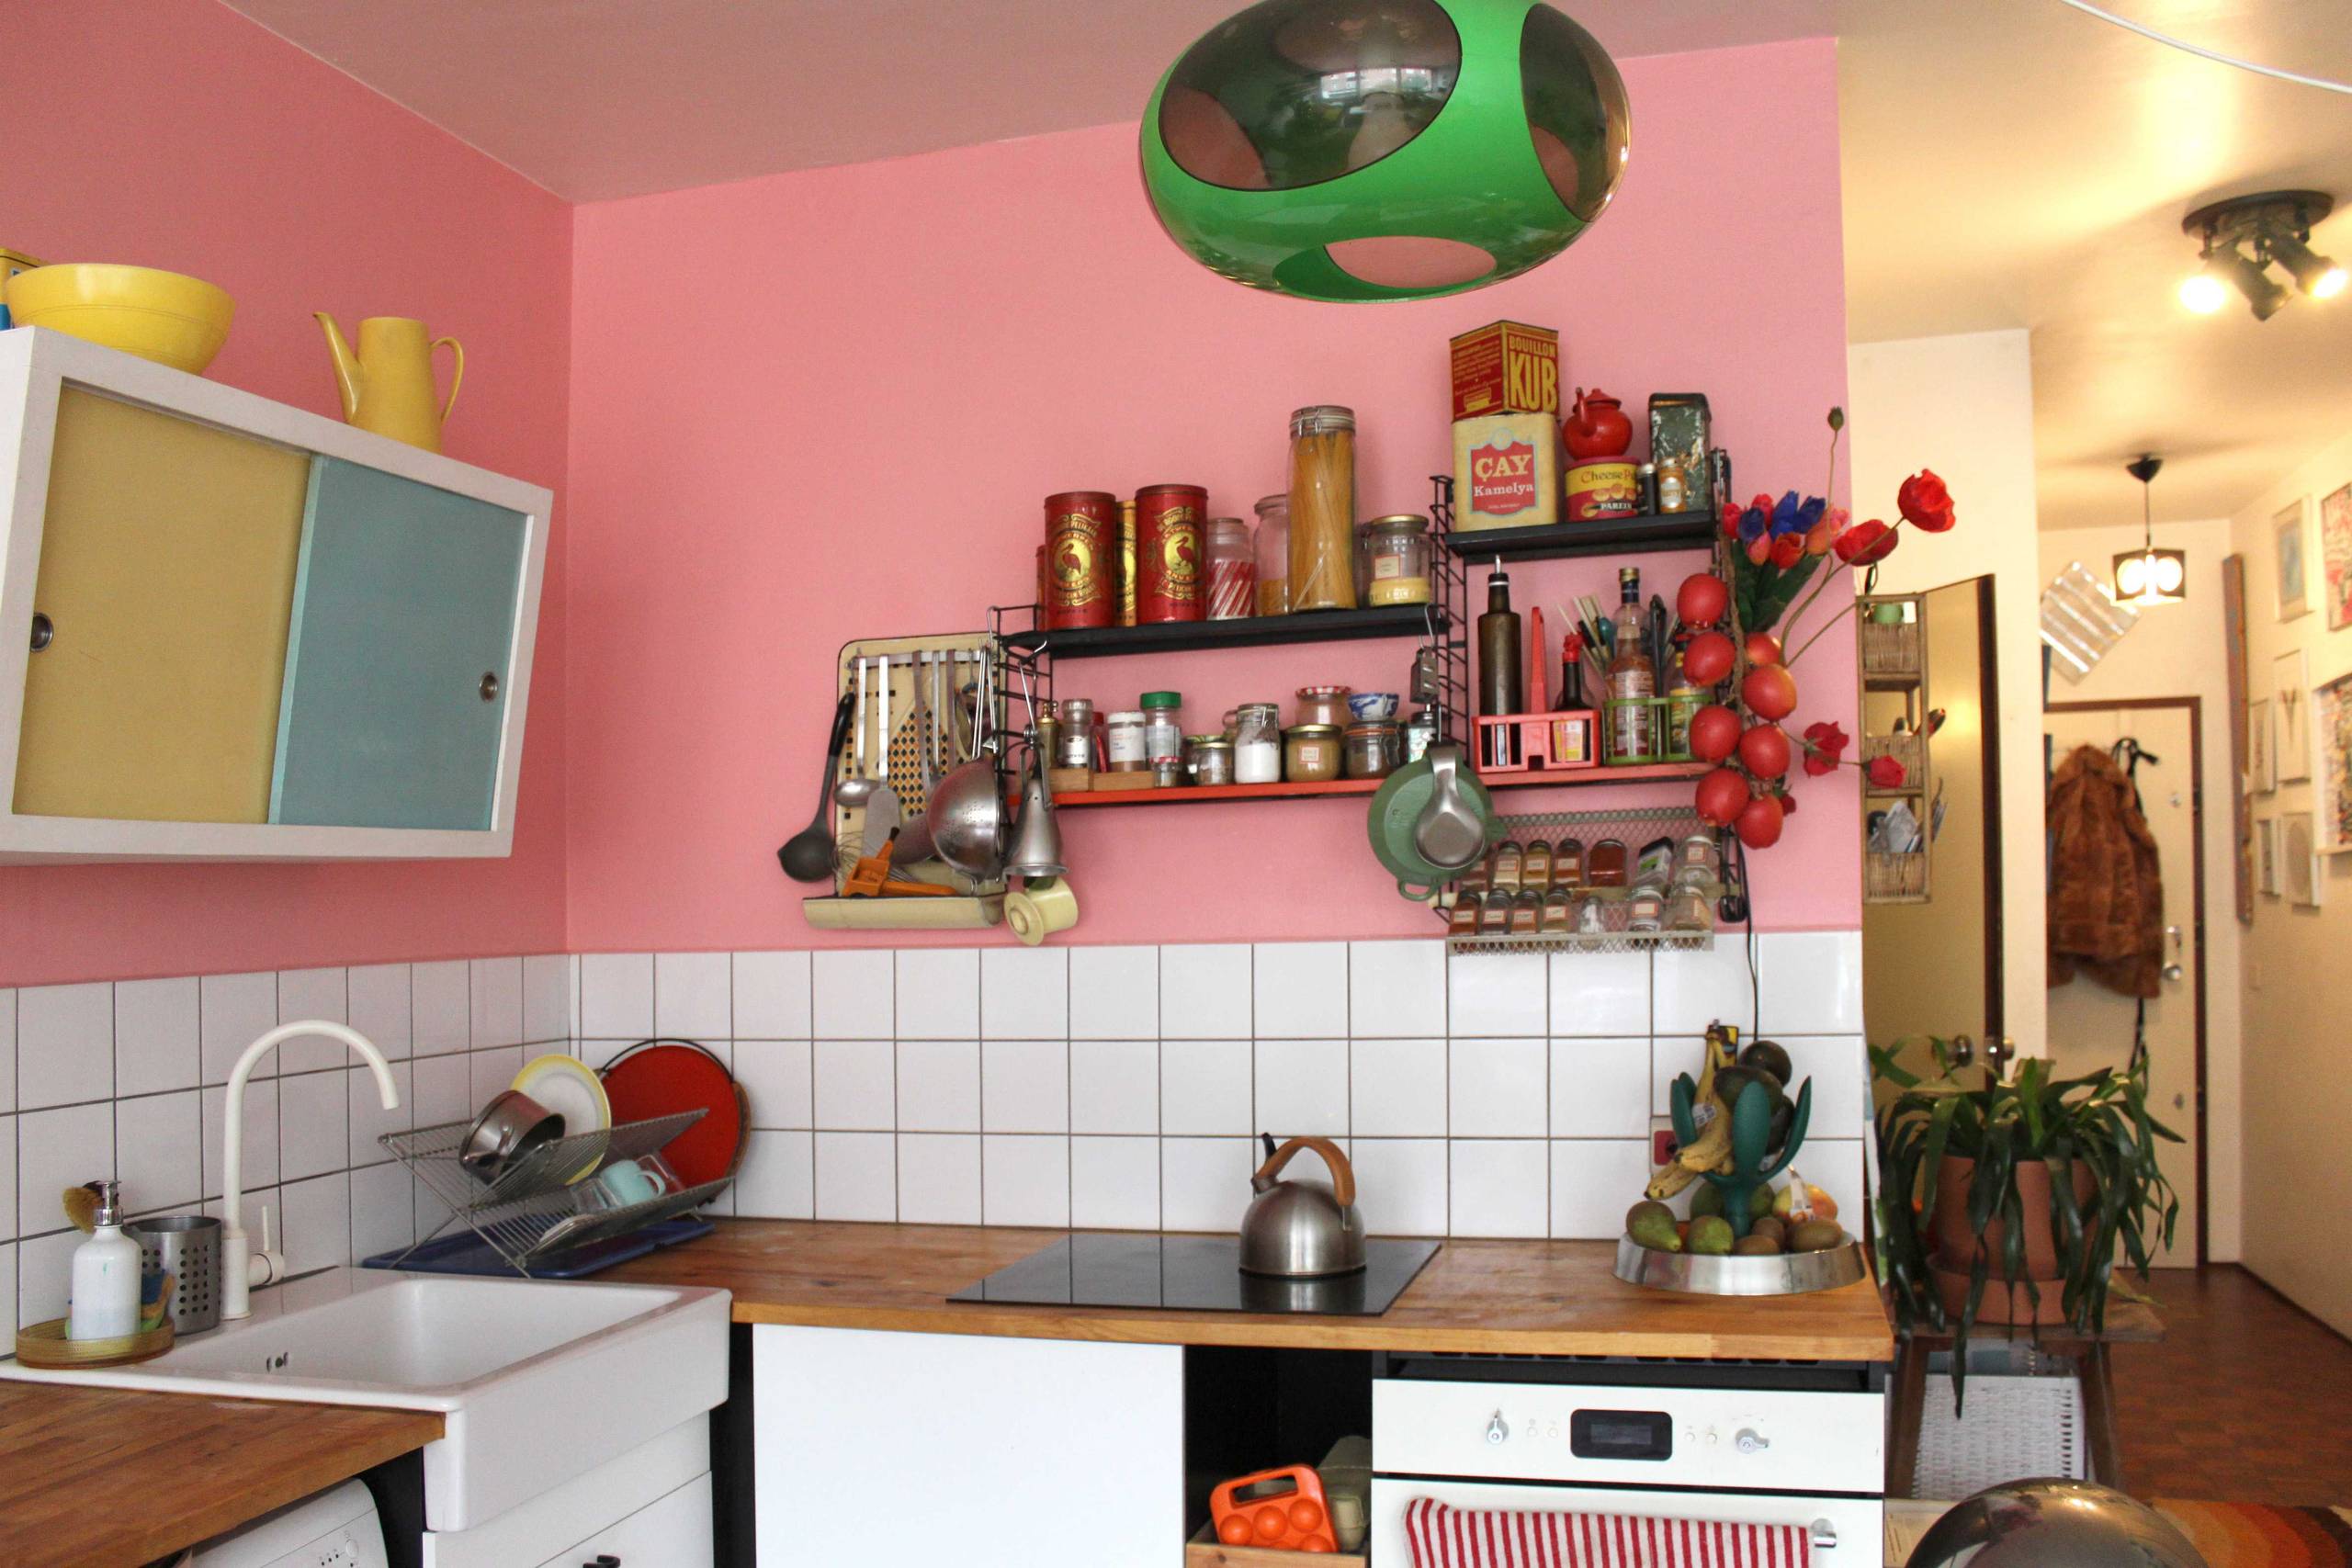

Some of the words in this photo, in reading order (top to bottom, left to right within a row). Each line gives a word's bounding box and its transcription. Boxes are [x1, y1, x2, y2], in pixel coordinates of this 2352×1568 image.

[1509, 334, 1556, 358] BOUILLON
[1510, 350, 1558, 412] KUB
[1475, 454, 1532, 482] ÇAY
[1580, 469, 1623, 483] Cheese
[1474, 482, 1533, 497] Kamelya
